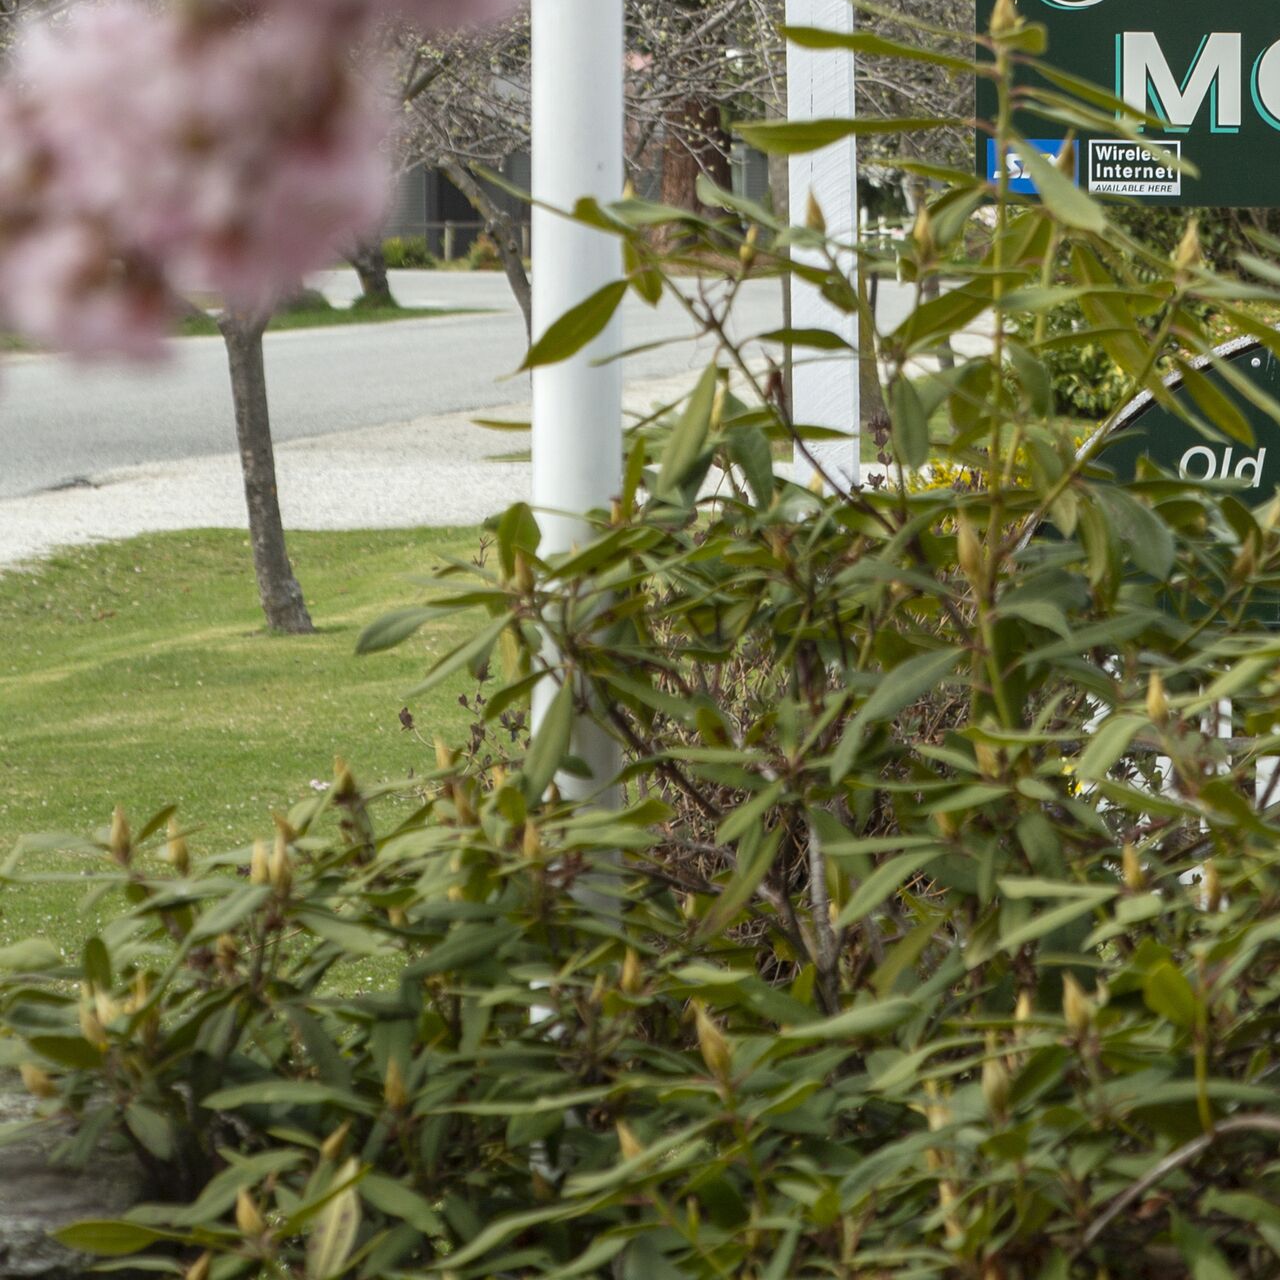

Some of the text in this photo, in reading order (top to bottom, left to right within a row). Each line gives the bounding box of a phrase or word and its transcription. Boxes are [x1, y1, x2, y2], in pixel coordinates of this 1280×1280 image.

[1096, 163, 1174, 179] Internet
[1095, 184, 1173, 193] AVAILABLE HERE
[1178, 445, 1267, 488] Old
